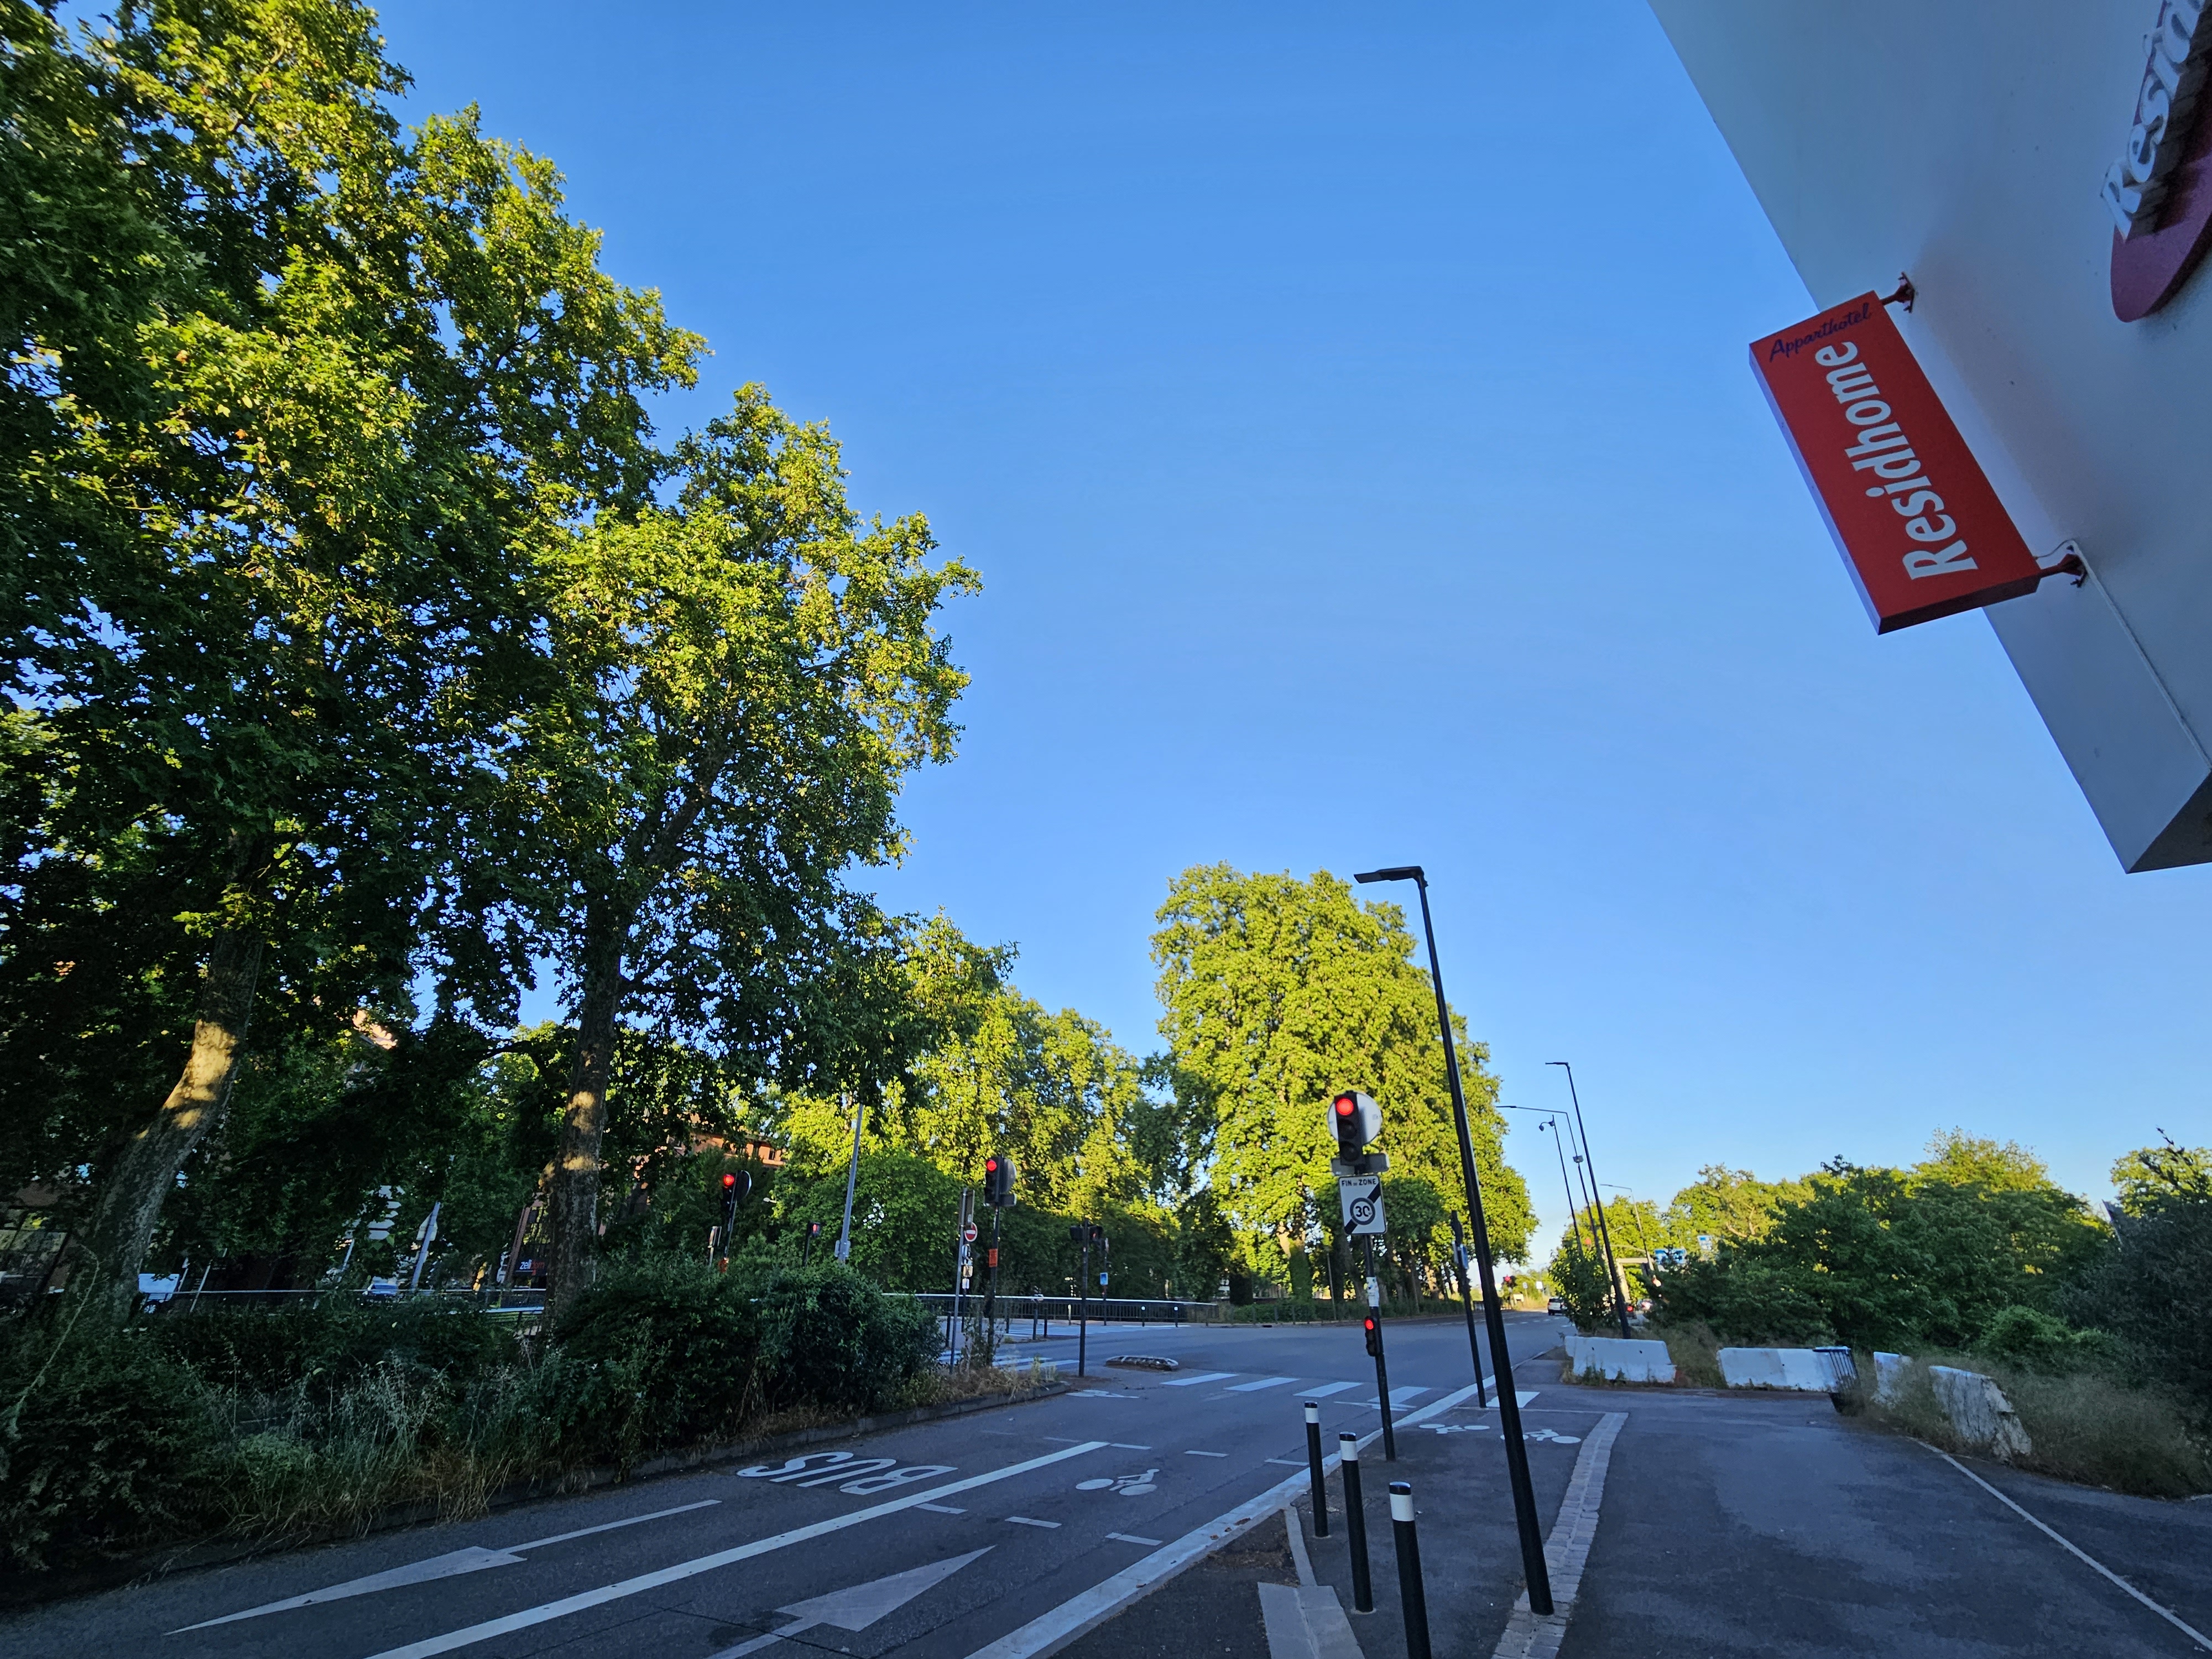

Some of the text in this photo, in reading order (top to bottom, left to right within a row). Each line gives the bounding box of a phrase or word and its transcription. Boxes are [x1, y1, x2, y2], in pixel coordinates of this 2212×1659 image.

[1770, 302, 1872, 363] Apparthotel
[1814, 341, 1978, 580] Residhome
[1355, 1206, 1371, 1217] 30
[736, 1452, 958, 1495] BUS
